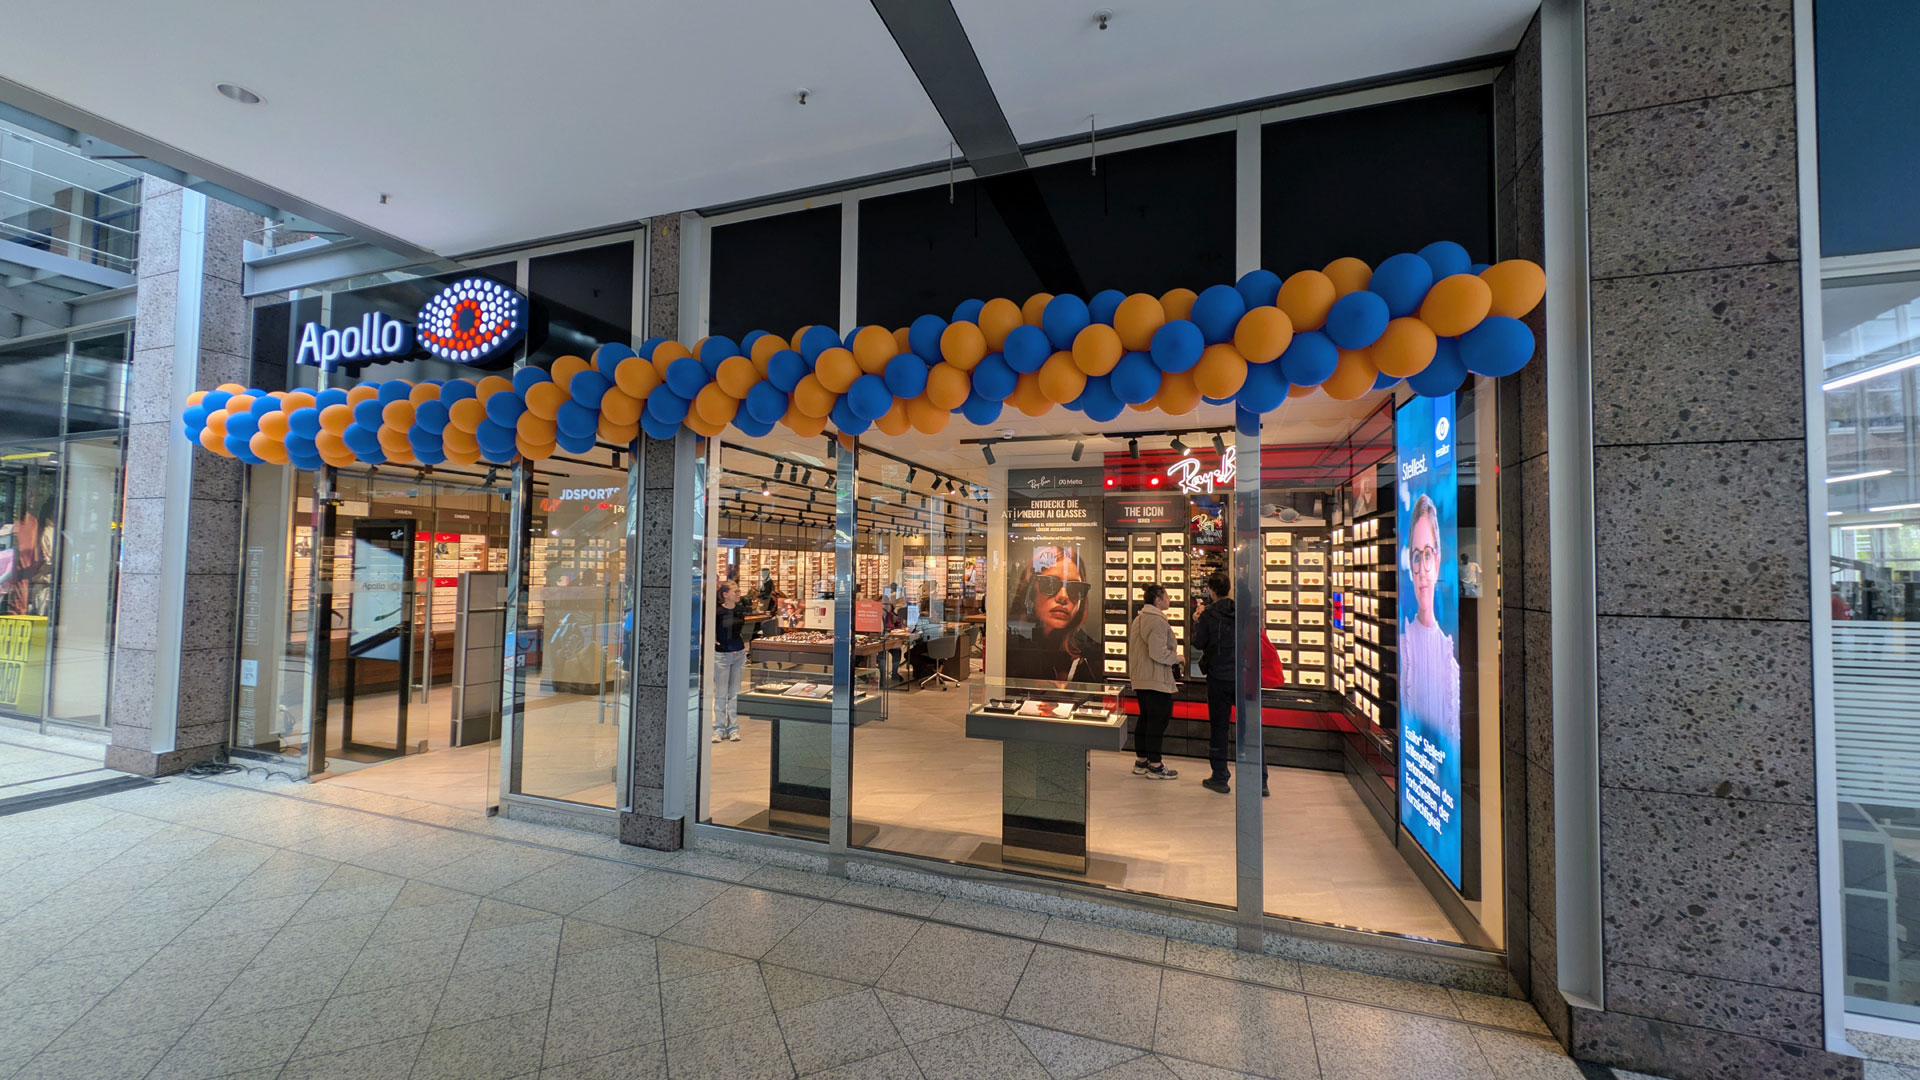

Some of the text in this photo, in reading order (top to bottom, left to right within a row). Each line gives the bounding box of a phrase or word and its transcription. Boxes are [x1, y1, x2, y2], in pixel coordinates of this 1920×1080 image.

[296, 311, 402, 371] Apollo
[1030, 499, 1079, 509] ENTDECKE DIE
[1022, 509, 1045, 518] NEUEN
[1047, 509, 1055, 518] AI
[1056, 509, 1087, 518] GLASSES
[1124, 506, 1164, 516] THE ICON
[362, 582, 386, 591] Apollo
